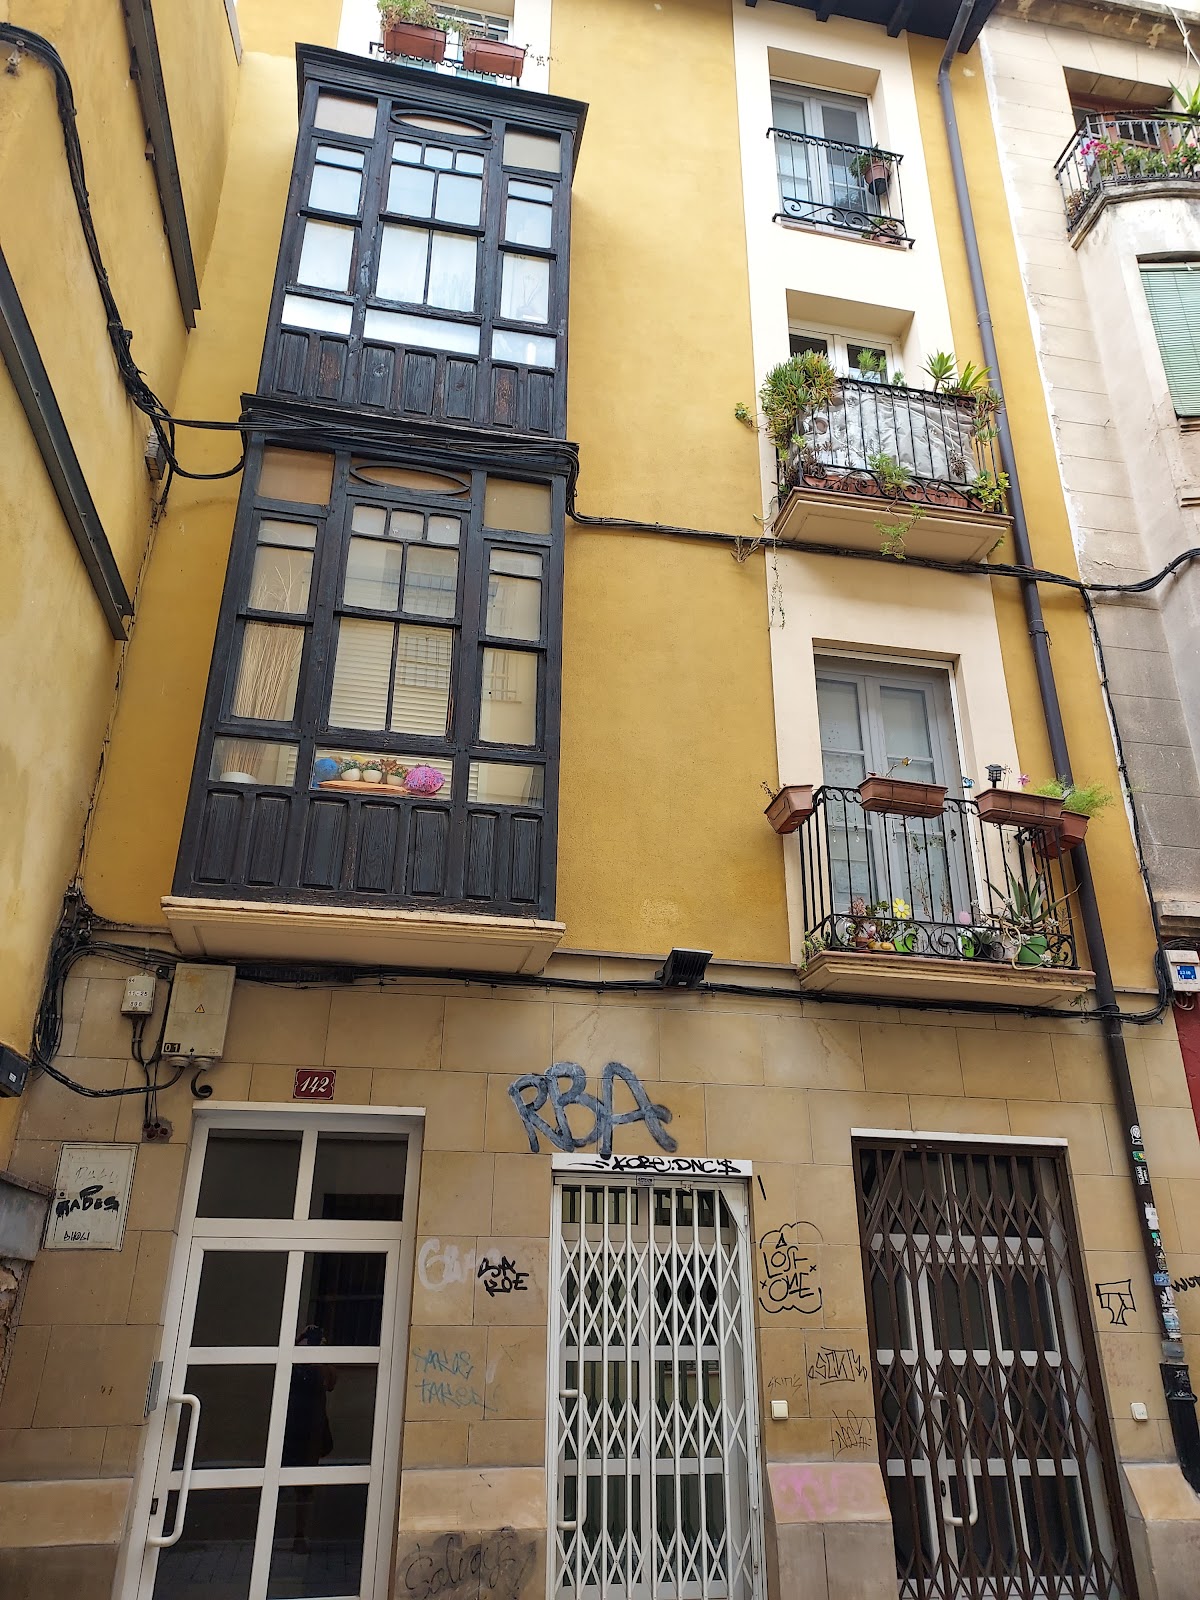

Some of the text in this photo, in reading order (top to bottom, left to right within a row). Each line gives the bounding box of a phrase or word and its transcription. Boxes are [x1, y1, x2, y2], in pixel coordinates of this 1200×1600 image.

[164, 1043, 181, 1053] 01
[299, 1076, 330, 1093] 142
[507, 1061, 679, 1159] RBA
